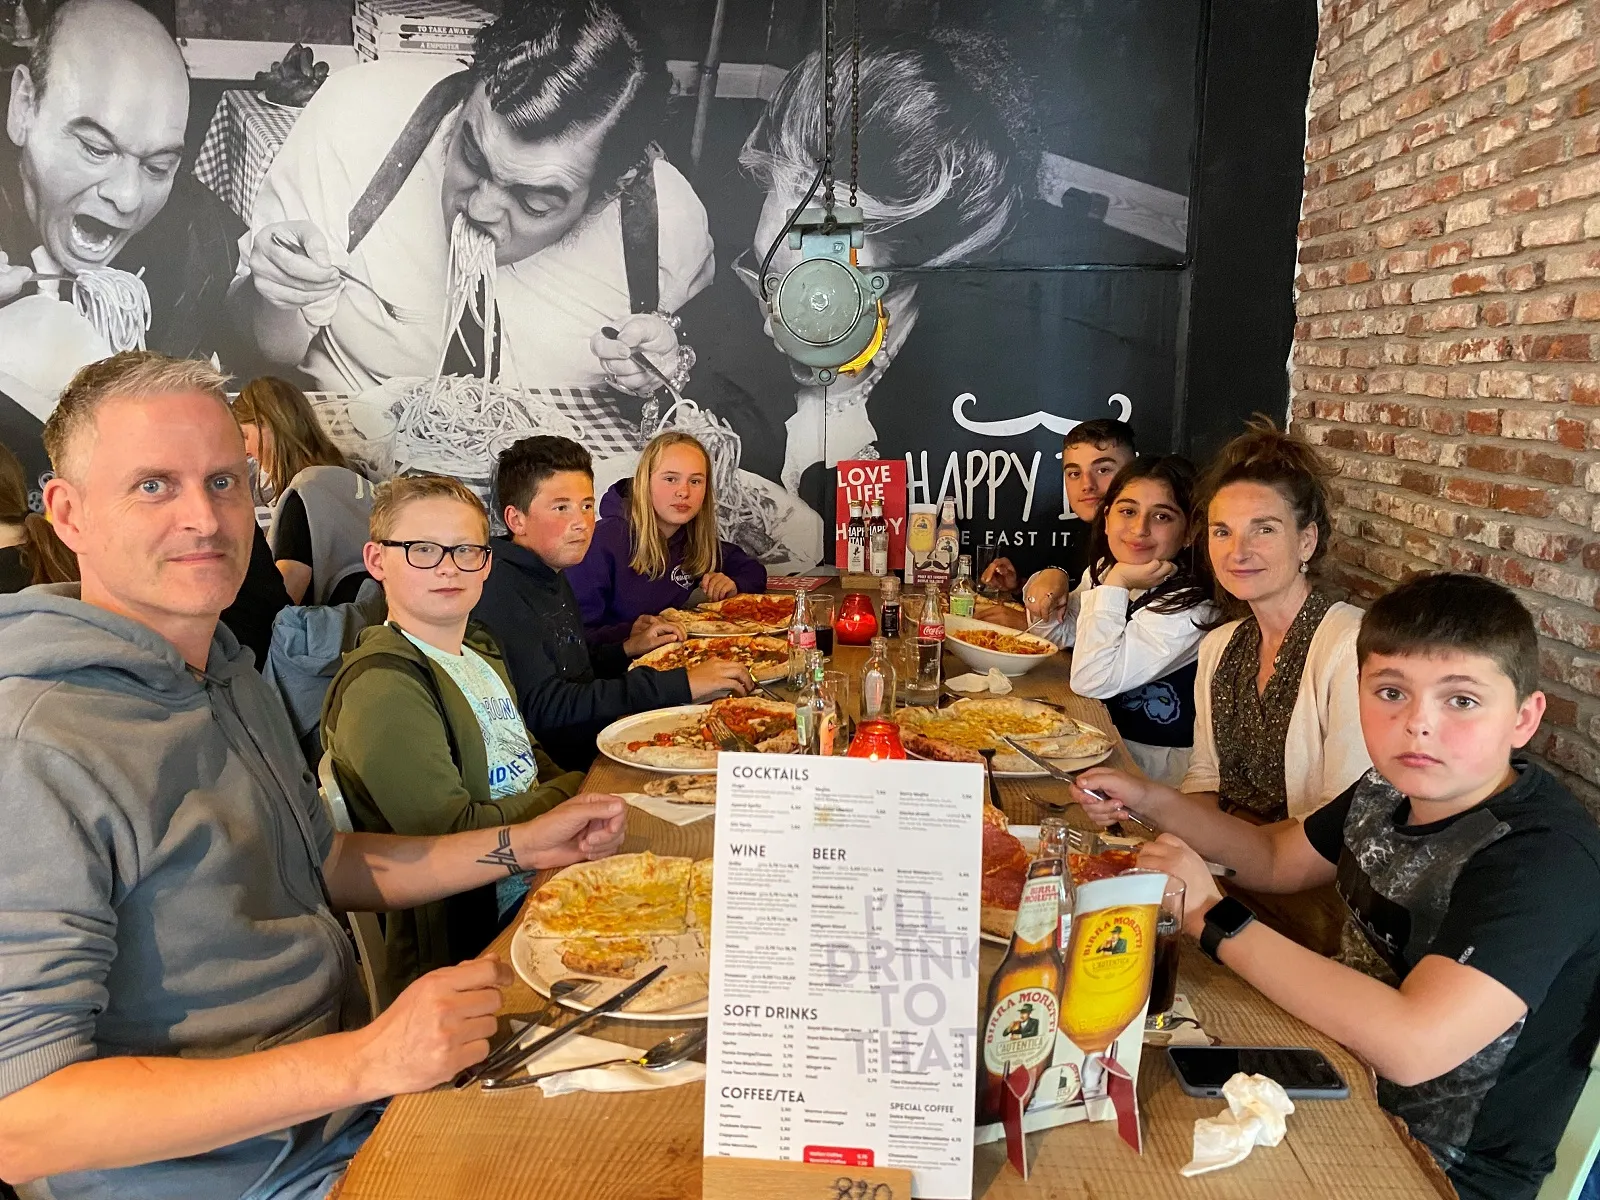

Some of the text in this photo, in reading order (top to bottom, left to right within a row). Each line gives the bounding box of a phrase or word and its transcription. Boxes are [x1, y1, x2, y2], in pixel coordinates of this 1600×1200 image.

[428, 26, 447, 34] TAKE
[448, 27, 470, 35] AWAY
[837, 465, 892, 488] LOVE
[905, 450, 1043, 522] HAPPY
[846, 483, 885, 506] LIFE
[985, 531, 1037, 547] FAST
[732, 766, 810, 781] COCKTAILS
[730, 844, 767, 857] WINE
[812, 847, 847, 861] BEER
[864, 892, 947, 937] I'LL
[1083, 917, 1143, 956] BIRRA MORETTI
[724, 1004, 818, 1021] SOFT DRINKS
[880, 983, 947, 1027] TO
[987, 998, 1016, 1044] BIRRA
[1018, 992, 1058, 1033] MORETTI
[844, 1027, 978, 1075] THAT
[721, 1086, 806, 1103] COFFEE/TEA
[890, 1102, 955, 1114] SPECIAL COFFEE
